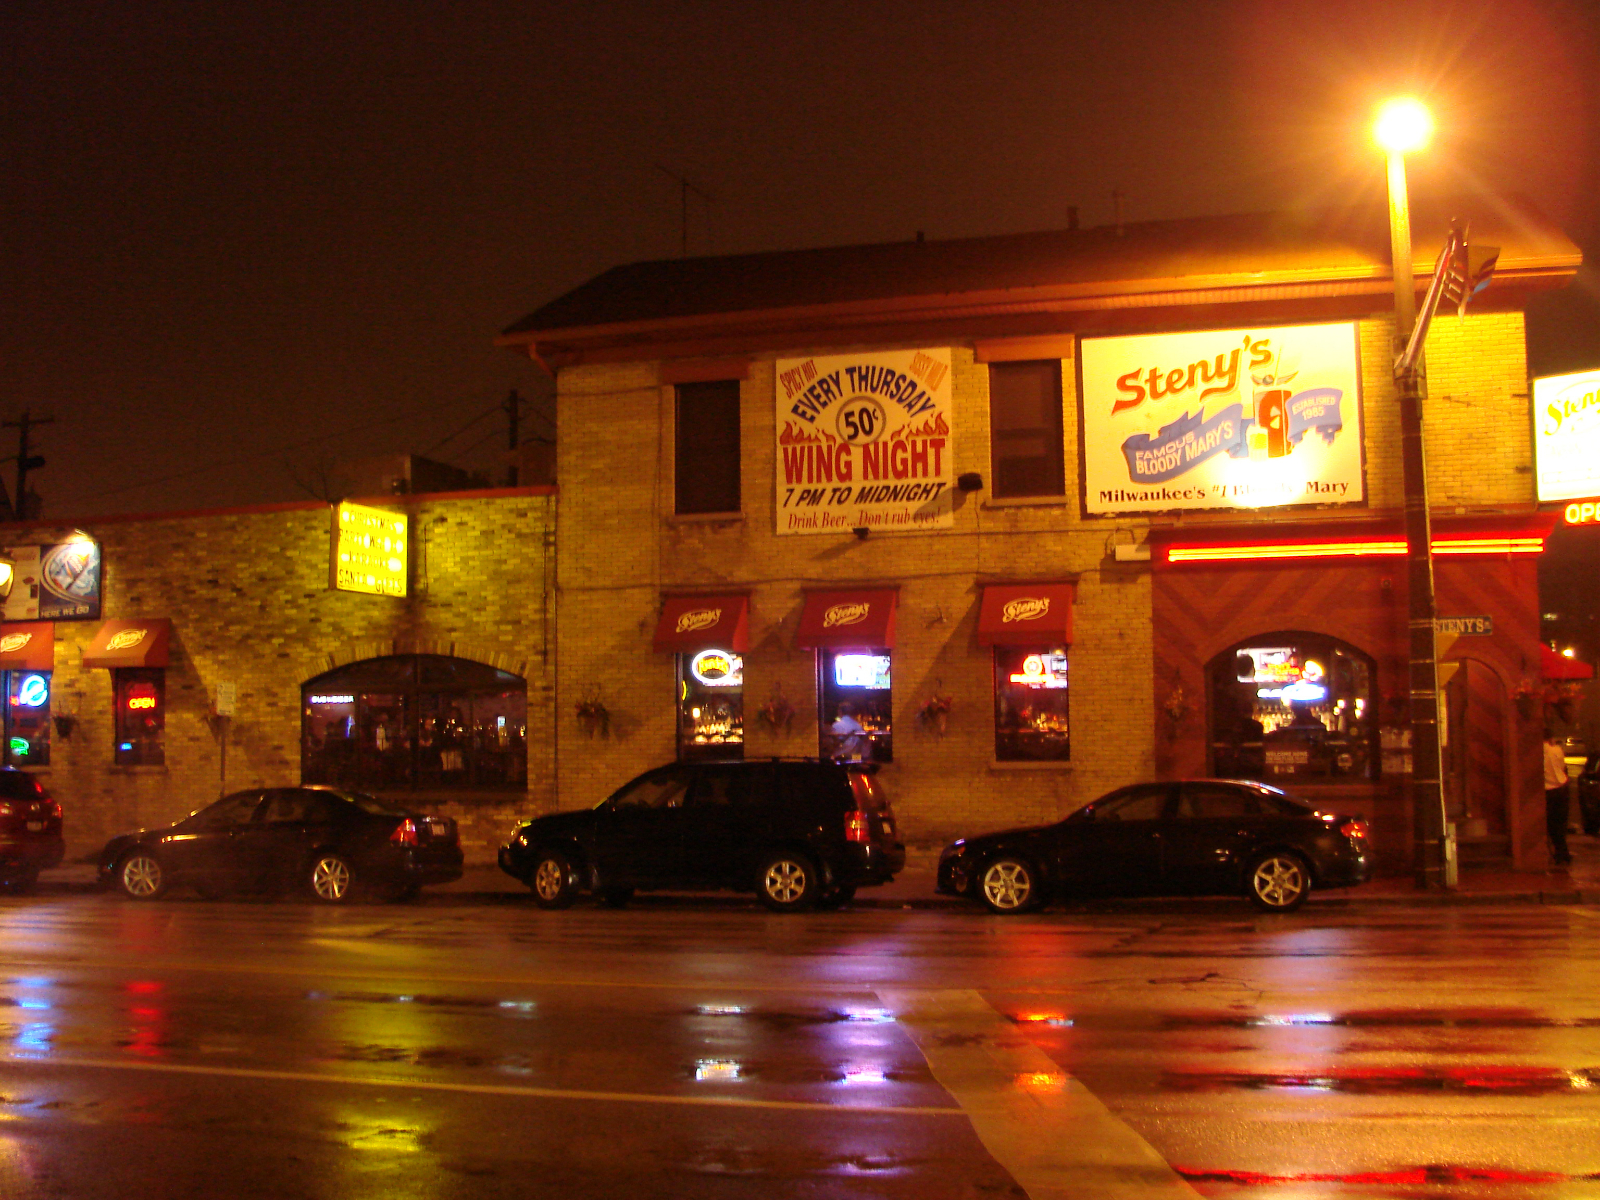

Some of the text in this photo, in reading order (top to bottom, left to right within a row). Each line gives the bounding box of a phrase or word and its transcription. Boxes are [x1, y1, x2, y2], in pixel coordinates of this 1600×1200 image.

[779, 359, 818, 400] SPICY HOT
[1111, 334, 1273, 417] Steny's
[790, 365, 936, 424] EVERY THURSDAY
[1291, 395, 1336, 416] ESTABLISHED
[1302, 406, 1325, 421] 1985
[1543, 387, 1600, 437] Sten
[1135, 431, 1195, 461] FAMOUS
[1135, 420, 1234, 475] BLOODY MARY'S
[783, 438, 946, 485] WING NIGHT
[783, 482, 946, 508] 7 PM TO MIDNIGHT
[1099, 486, 1206, 504] Milwaukee's
[1211, 484, 1227, 499] #1
[1306, 481, 1349, 497] Mary
[788, 512, 818, 530] Drink
[858, 509, 889, 527] Don't
[891, 507, 911, 524] rub
[913, 507, 941, 528] eyes!
[338, 568, 368, 587] SANTA
[62, 607, 75, 616] WE
[76, 605, 90, 615] GO
[129, 697, 156, 709] OPEN
